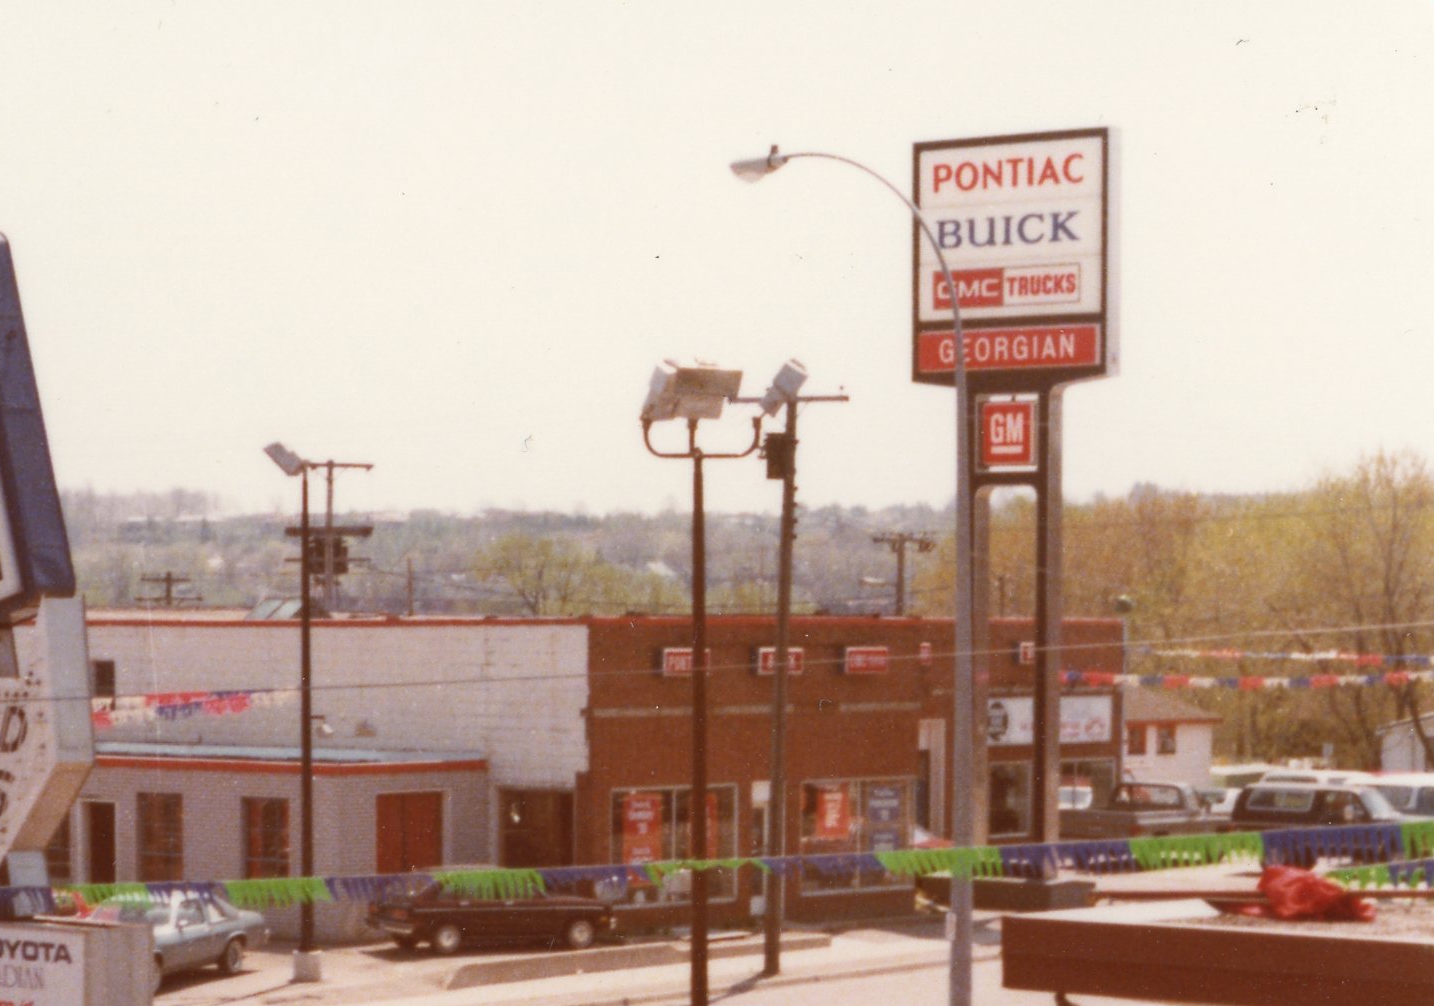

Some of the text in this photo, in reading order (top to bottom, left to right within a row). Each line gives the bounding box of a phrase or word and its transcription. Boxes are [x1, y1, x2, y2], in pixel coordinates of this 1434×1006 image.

[933, 153, 1084, 193] PONTIAC
[936, 210, 1081, 250] BUICK
[1006, 273, 1076, 299] TRUCKS
[990, 412, 1024, 444] GM
